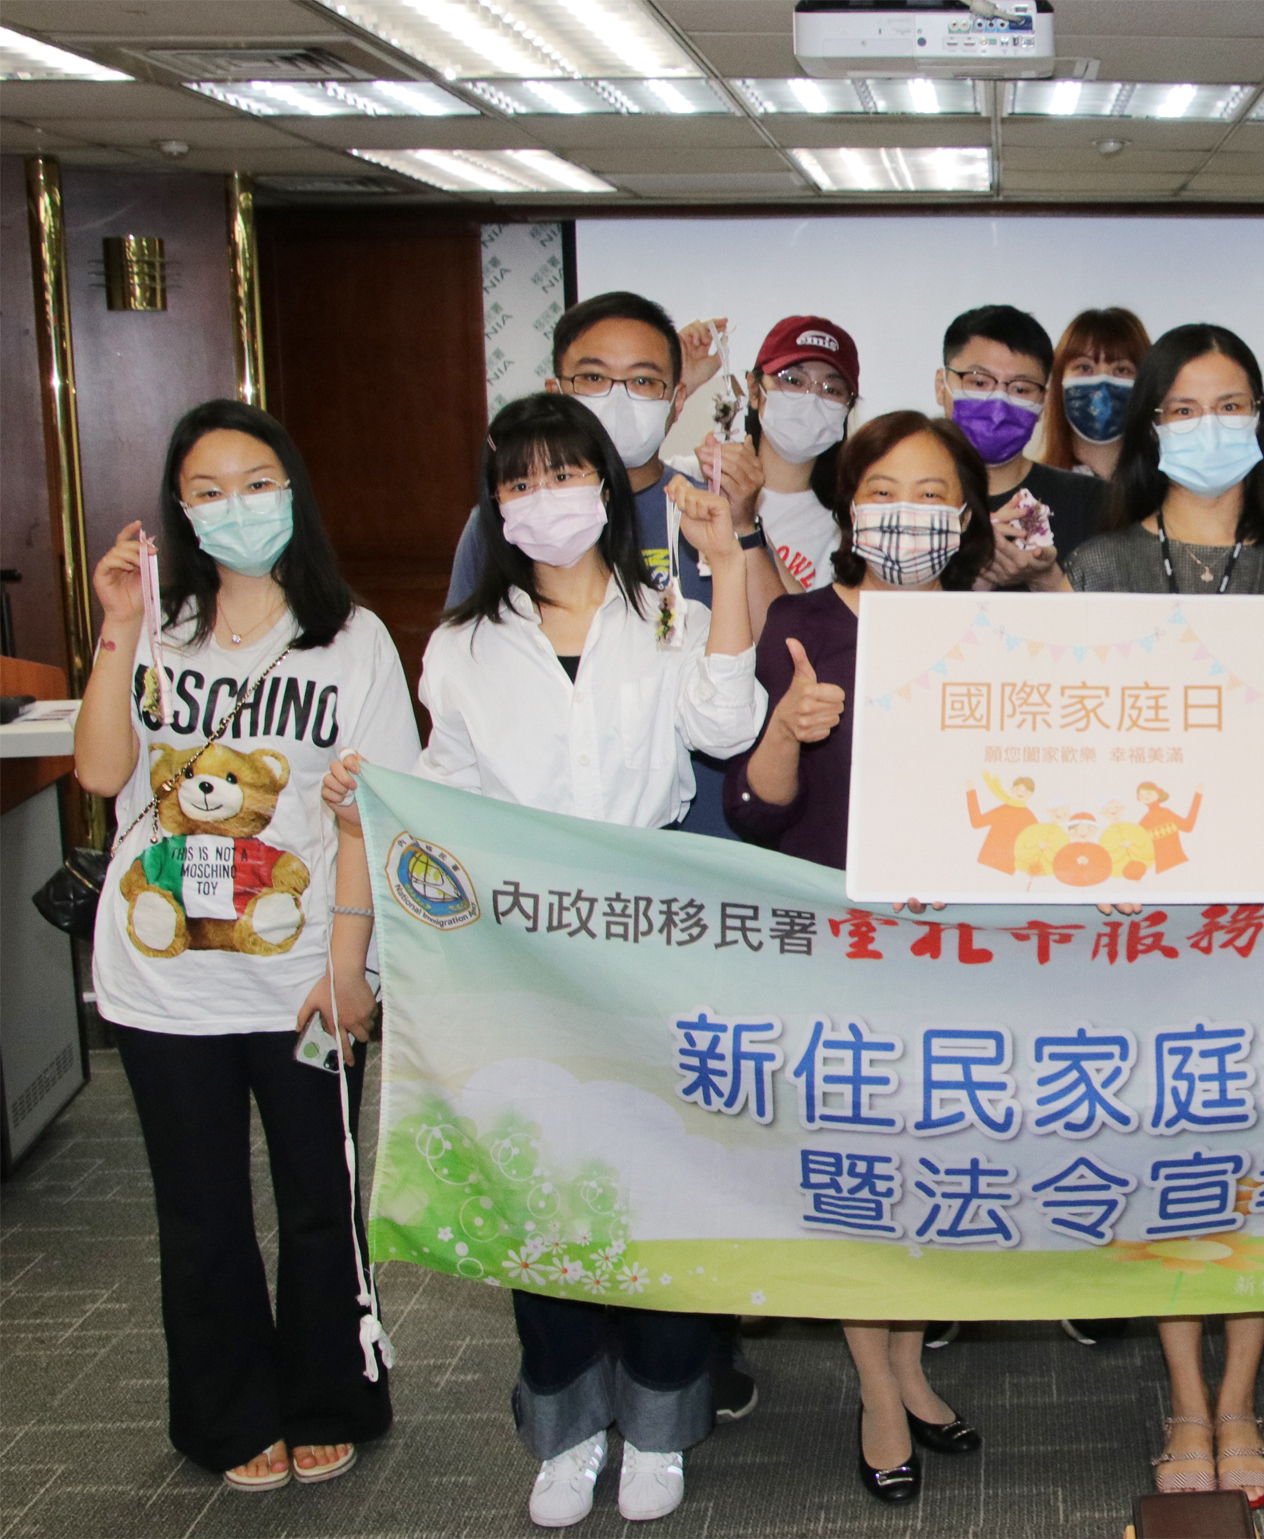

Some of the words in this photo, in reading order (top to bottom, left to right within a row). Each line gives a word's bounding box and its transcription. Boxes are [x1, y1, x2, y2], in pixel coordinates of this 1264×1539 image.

[940, 680, 1223, 733] 國際家庭日
[984, 746, 1097, 764] 願您闔家歡樂
[1110, 746, 1184, 764] 幸福美滿
[172, 846, 194, 862] THIS
[199, 846, 209, 862] IS
[216, 846, 237, 862] NOT
[241, 848, 248, 862] A
[181, 863, 237, 879] MOSCHINO
[196, 881, 218, 896] TOY
[492, 881, 818, 956] 內政部移民署
